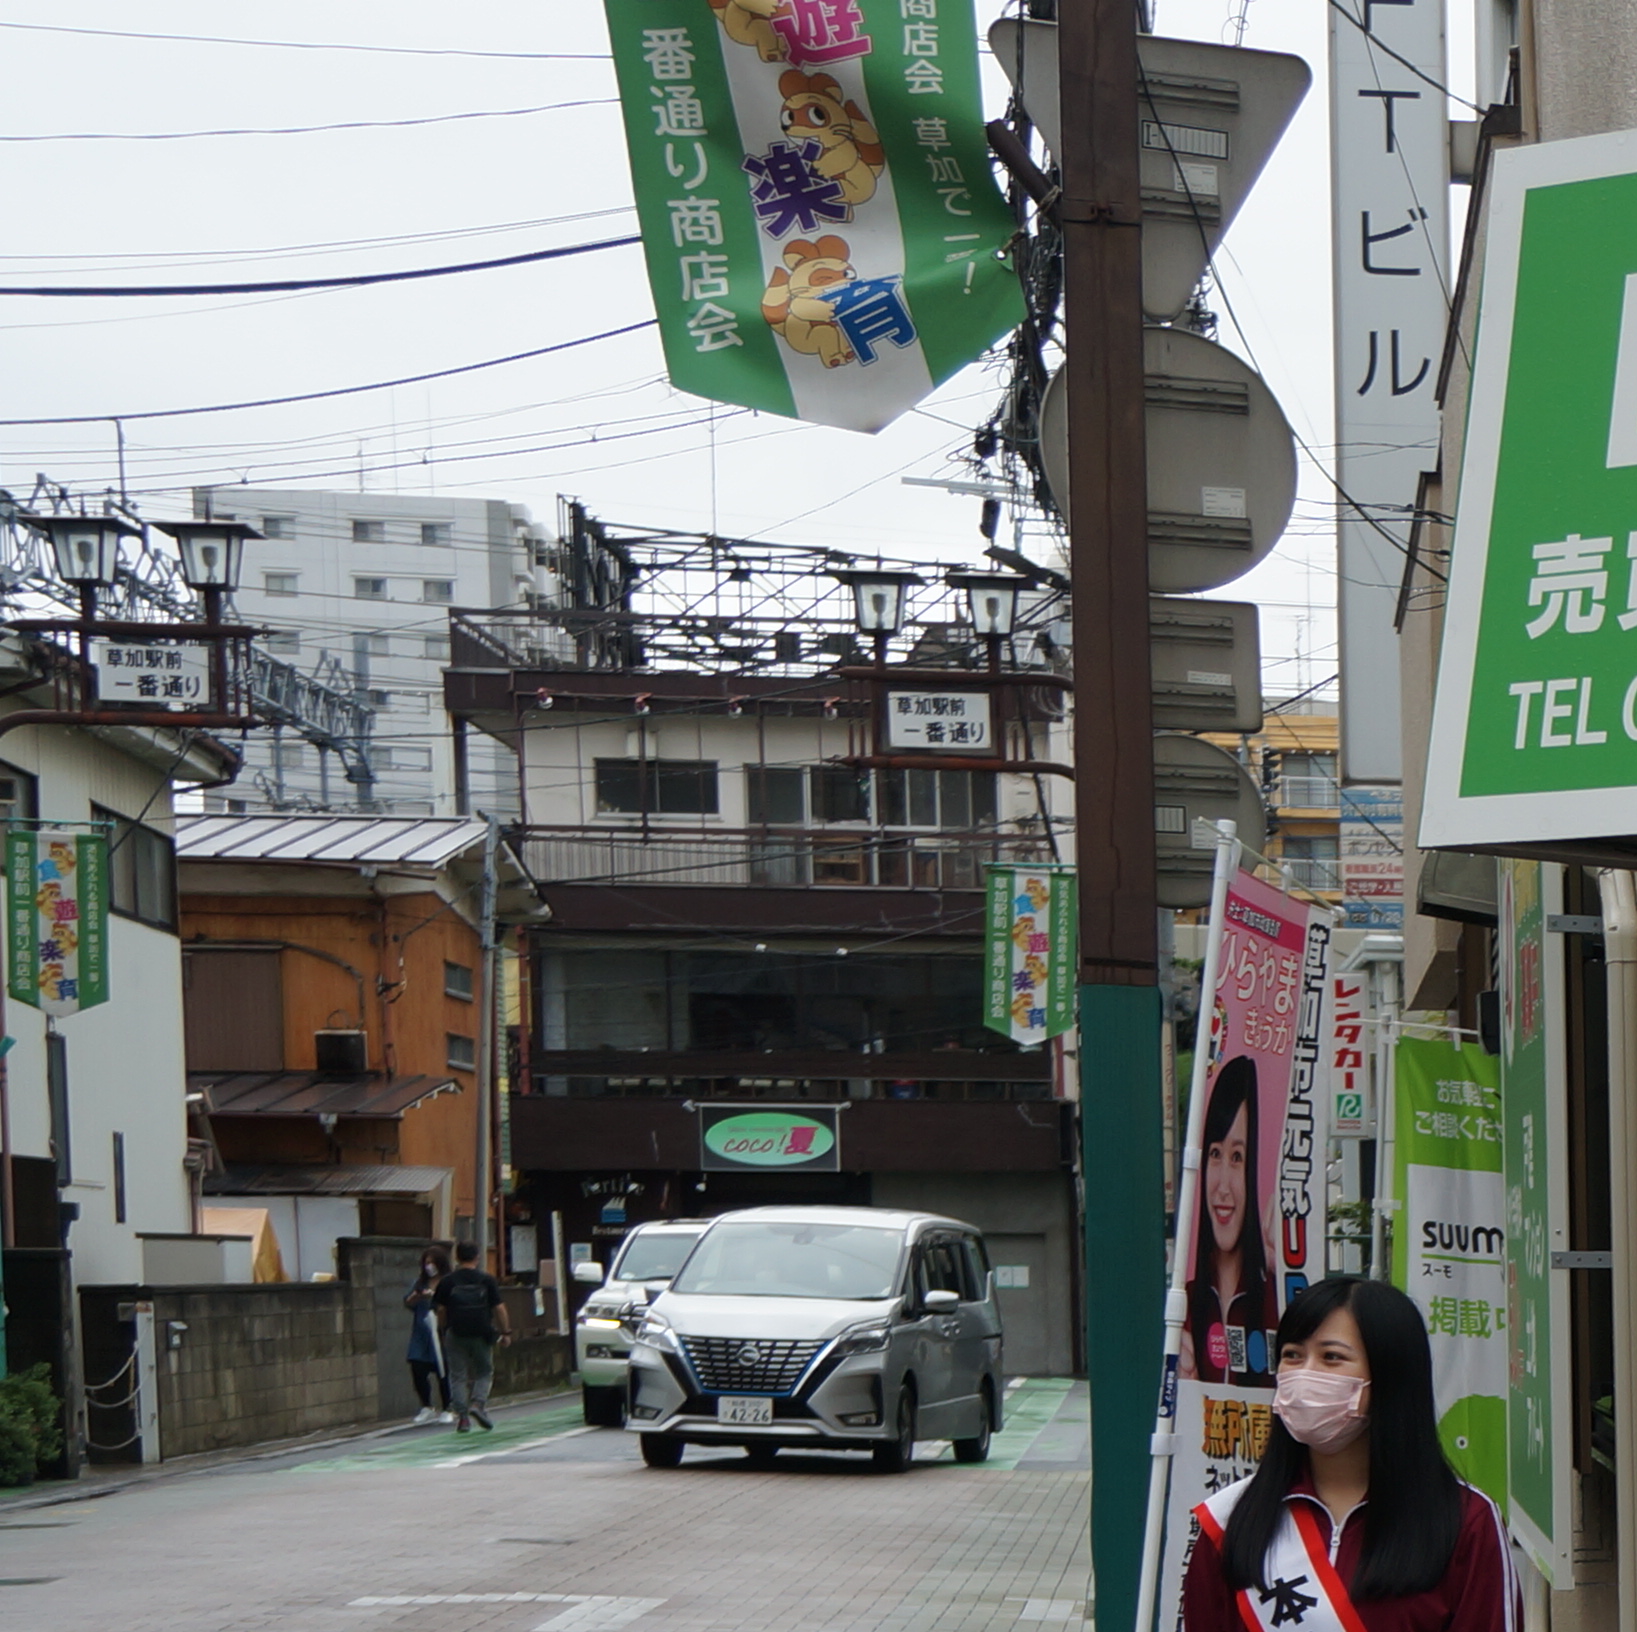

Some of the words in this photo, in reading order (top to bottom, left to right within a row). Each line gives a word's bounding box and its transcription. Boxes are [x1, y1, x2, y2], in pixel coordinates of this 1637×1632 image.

[742, 142, 849, 240] 楽
[816, 274, 919, 367] 育
[107, 648, 182, 669] 草加駅前
[115, 674, 200, 698] 一番通り
[897, 697, 966, 716] 草加駅前
[1508, 678, 1607, 750] TEL
[904, 721, 984, 743] 一番通り
[1214, 928, 1300, 1016] ひらやま
[1244, 1006, 1292, 1056] きょうか
[1333, 978, 1363, 1090] レンタカー
[1436, 1079, 1496, 1109] お気軽に
[1422, 1262, 1453, 1279] スーモ
[1204, 1464, 1255, 1494] ネット
